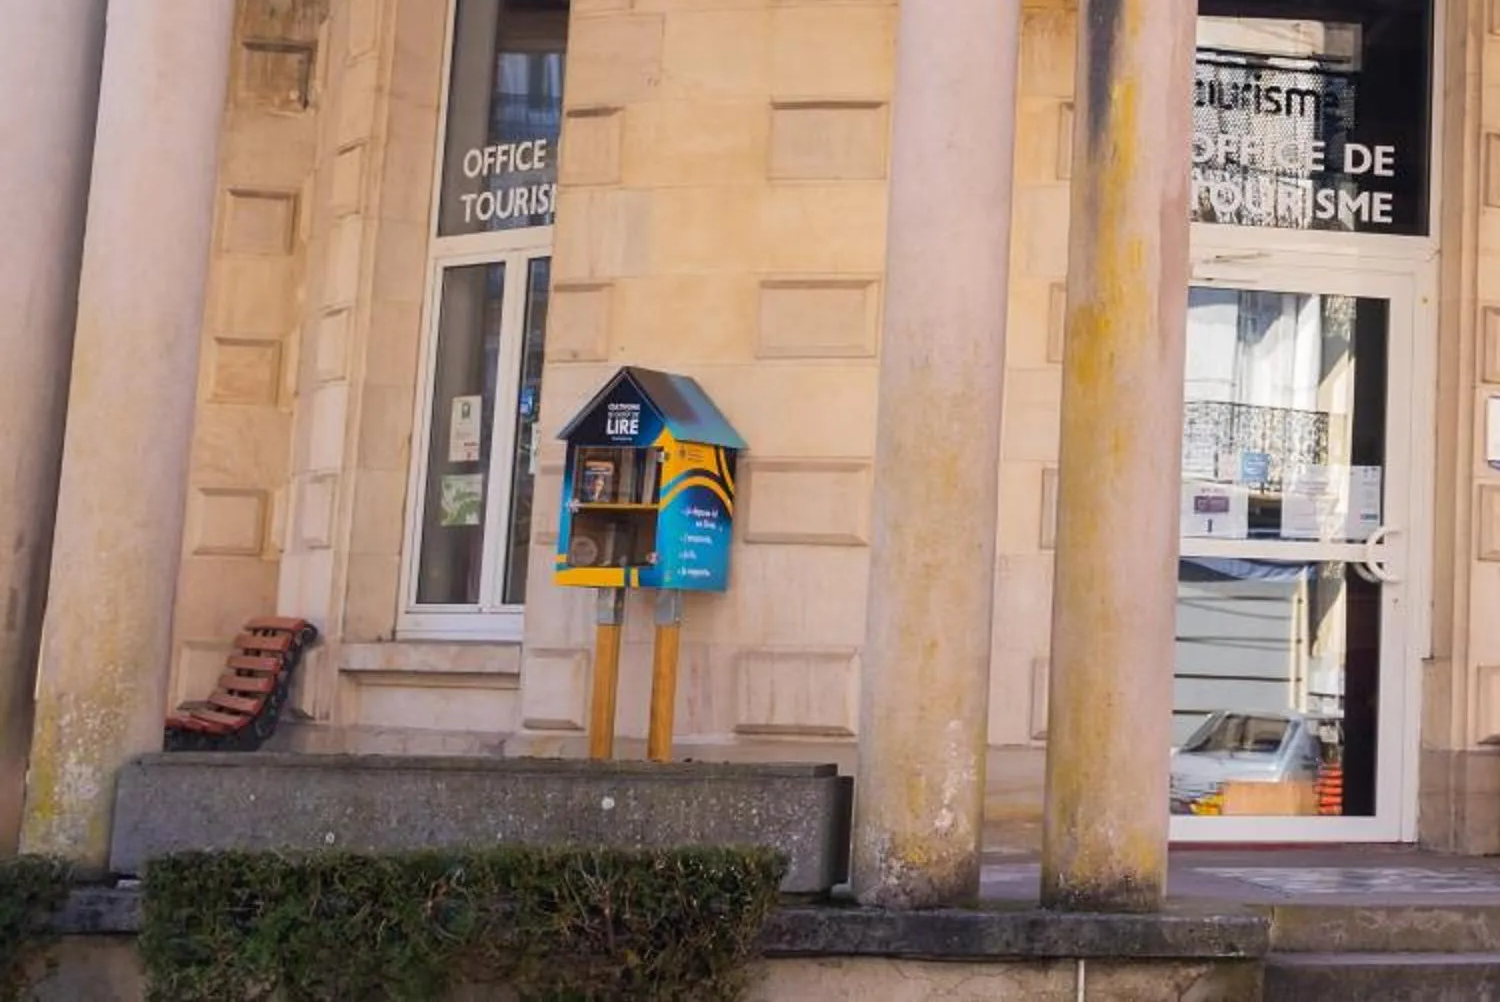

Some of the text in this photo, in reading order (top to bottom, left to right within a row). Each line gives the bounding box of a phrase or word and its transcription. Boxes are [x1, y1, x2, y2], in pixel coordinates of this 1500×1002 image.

[463, 138, 548, 178] OFFICE
[1193, 132, 1395, 177] OFFICE DE
[606, 418, 640, 435] LIRE
